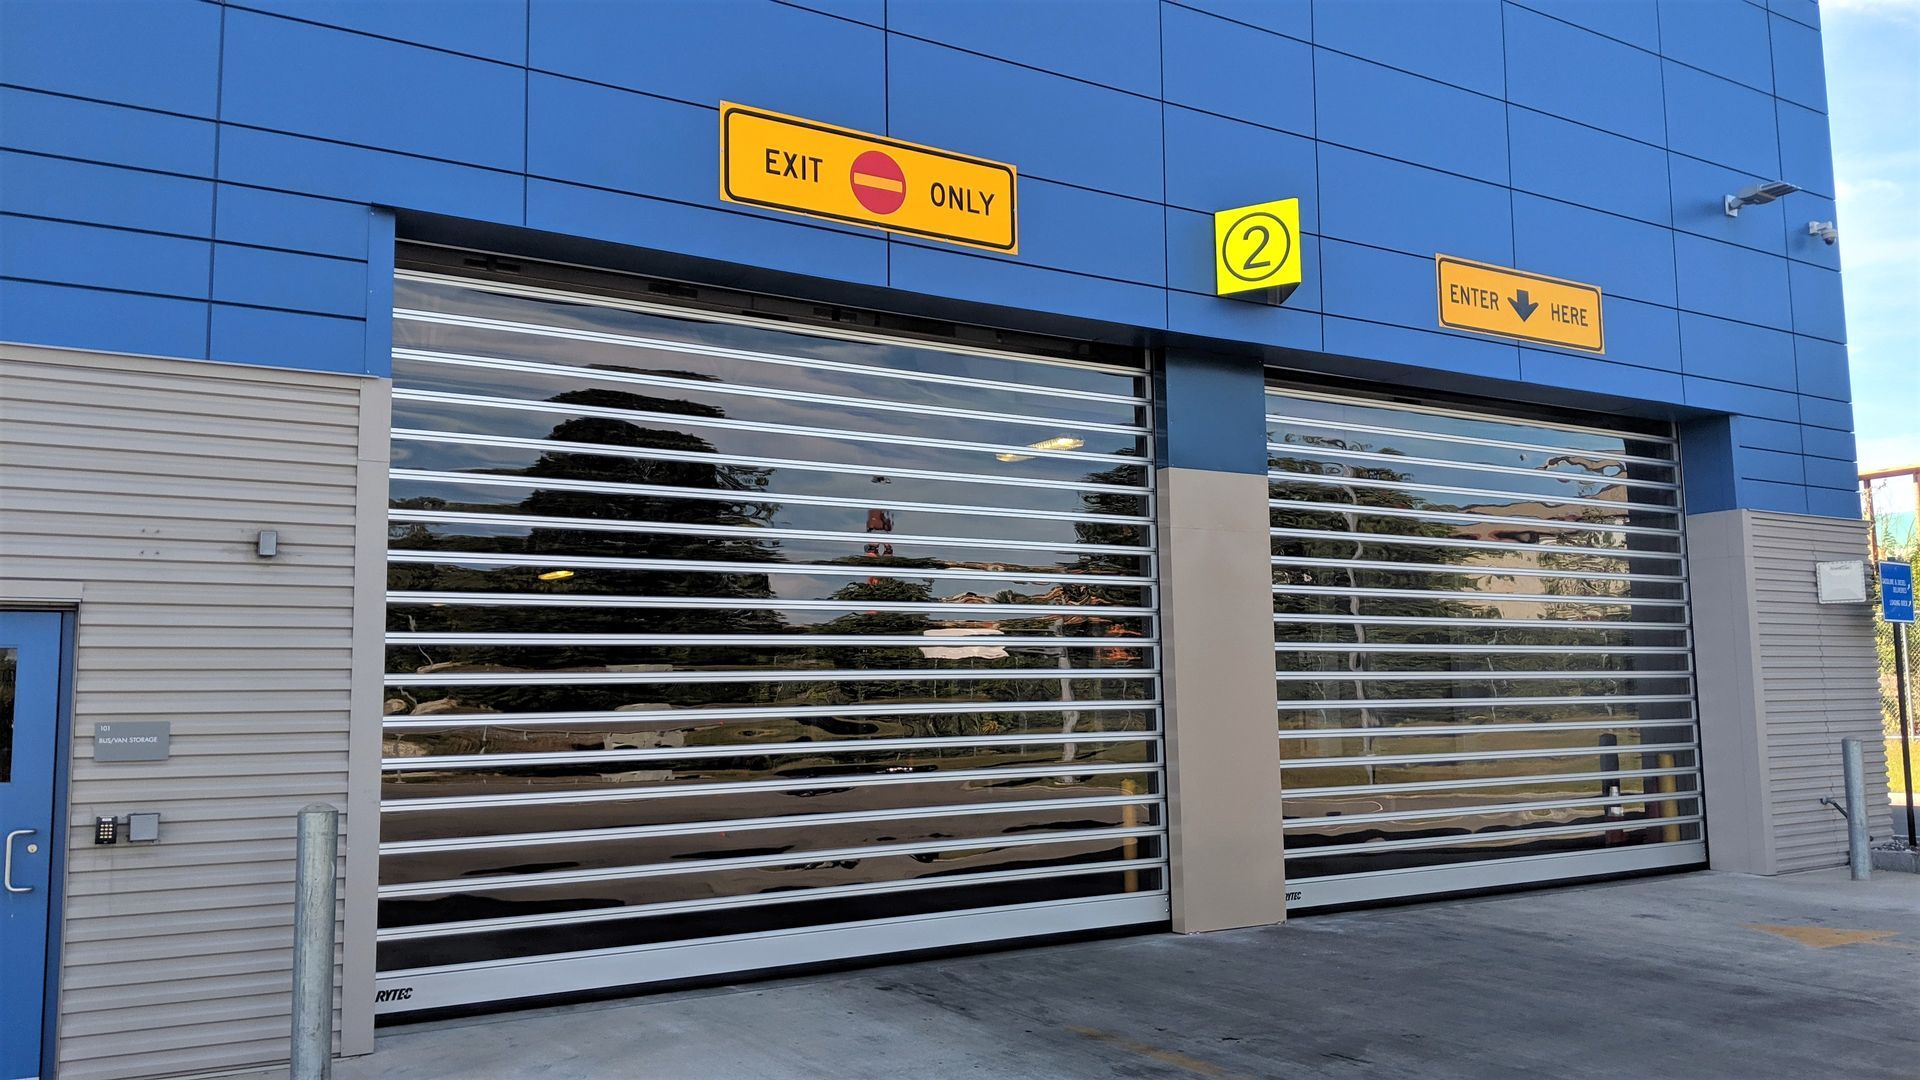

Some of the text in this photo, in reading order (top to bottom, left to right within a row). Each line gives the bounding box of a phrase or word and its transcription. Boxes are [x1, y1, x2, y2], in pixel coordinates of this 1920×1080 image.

[765, 147, 995, 216] EXIT ONLY
[1243, 225, 1271, 270] 2
[1450, 283, 1589, 327] ENTER HERE
[375, 987, 413, 1003] RYTEC
